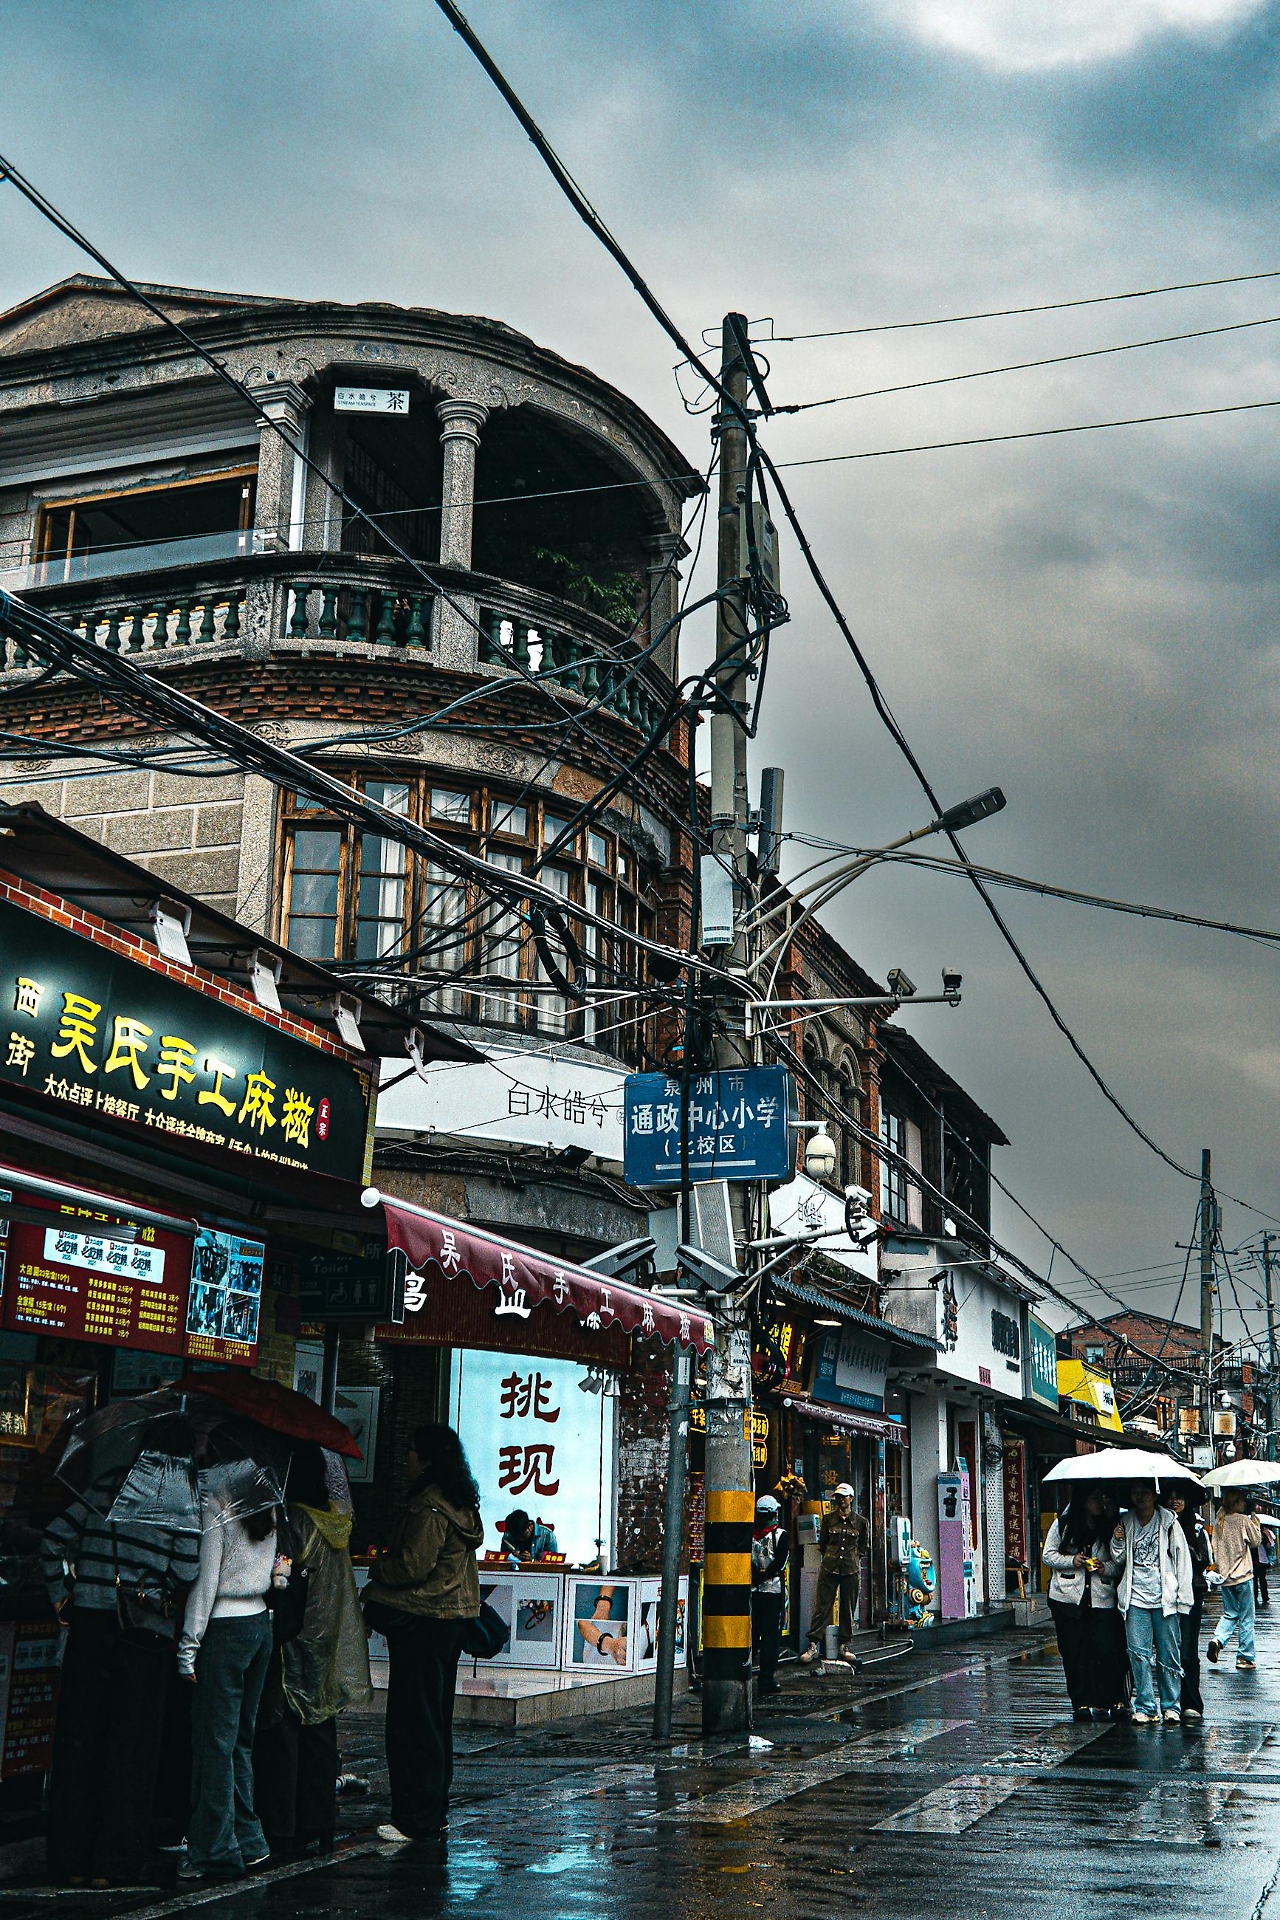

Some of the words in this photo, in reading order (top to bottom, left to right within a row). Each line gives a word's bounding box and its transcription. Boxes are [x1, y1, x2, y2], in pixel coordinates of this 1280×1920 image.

[387, 392, 404, 410] 茶
[6, 977, 45, 1076] 西街
[51, 992, 315, 1149] 吴氏手工麻糍
[664, 1074, 745, 1097] 泉州市
[508, 1081, 609, 1128] 白水皓兮
[631, 1097, 780, 1135] 通政中心小学
[495, 1371, 560, 1532] 挑现
